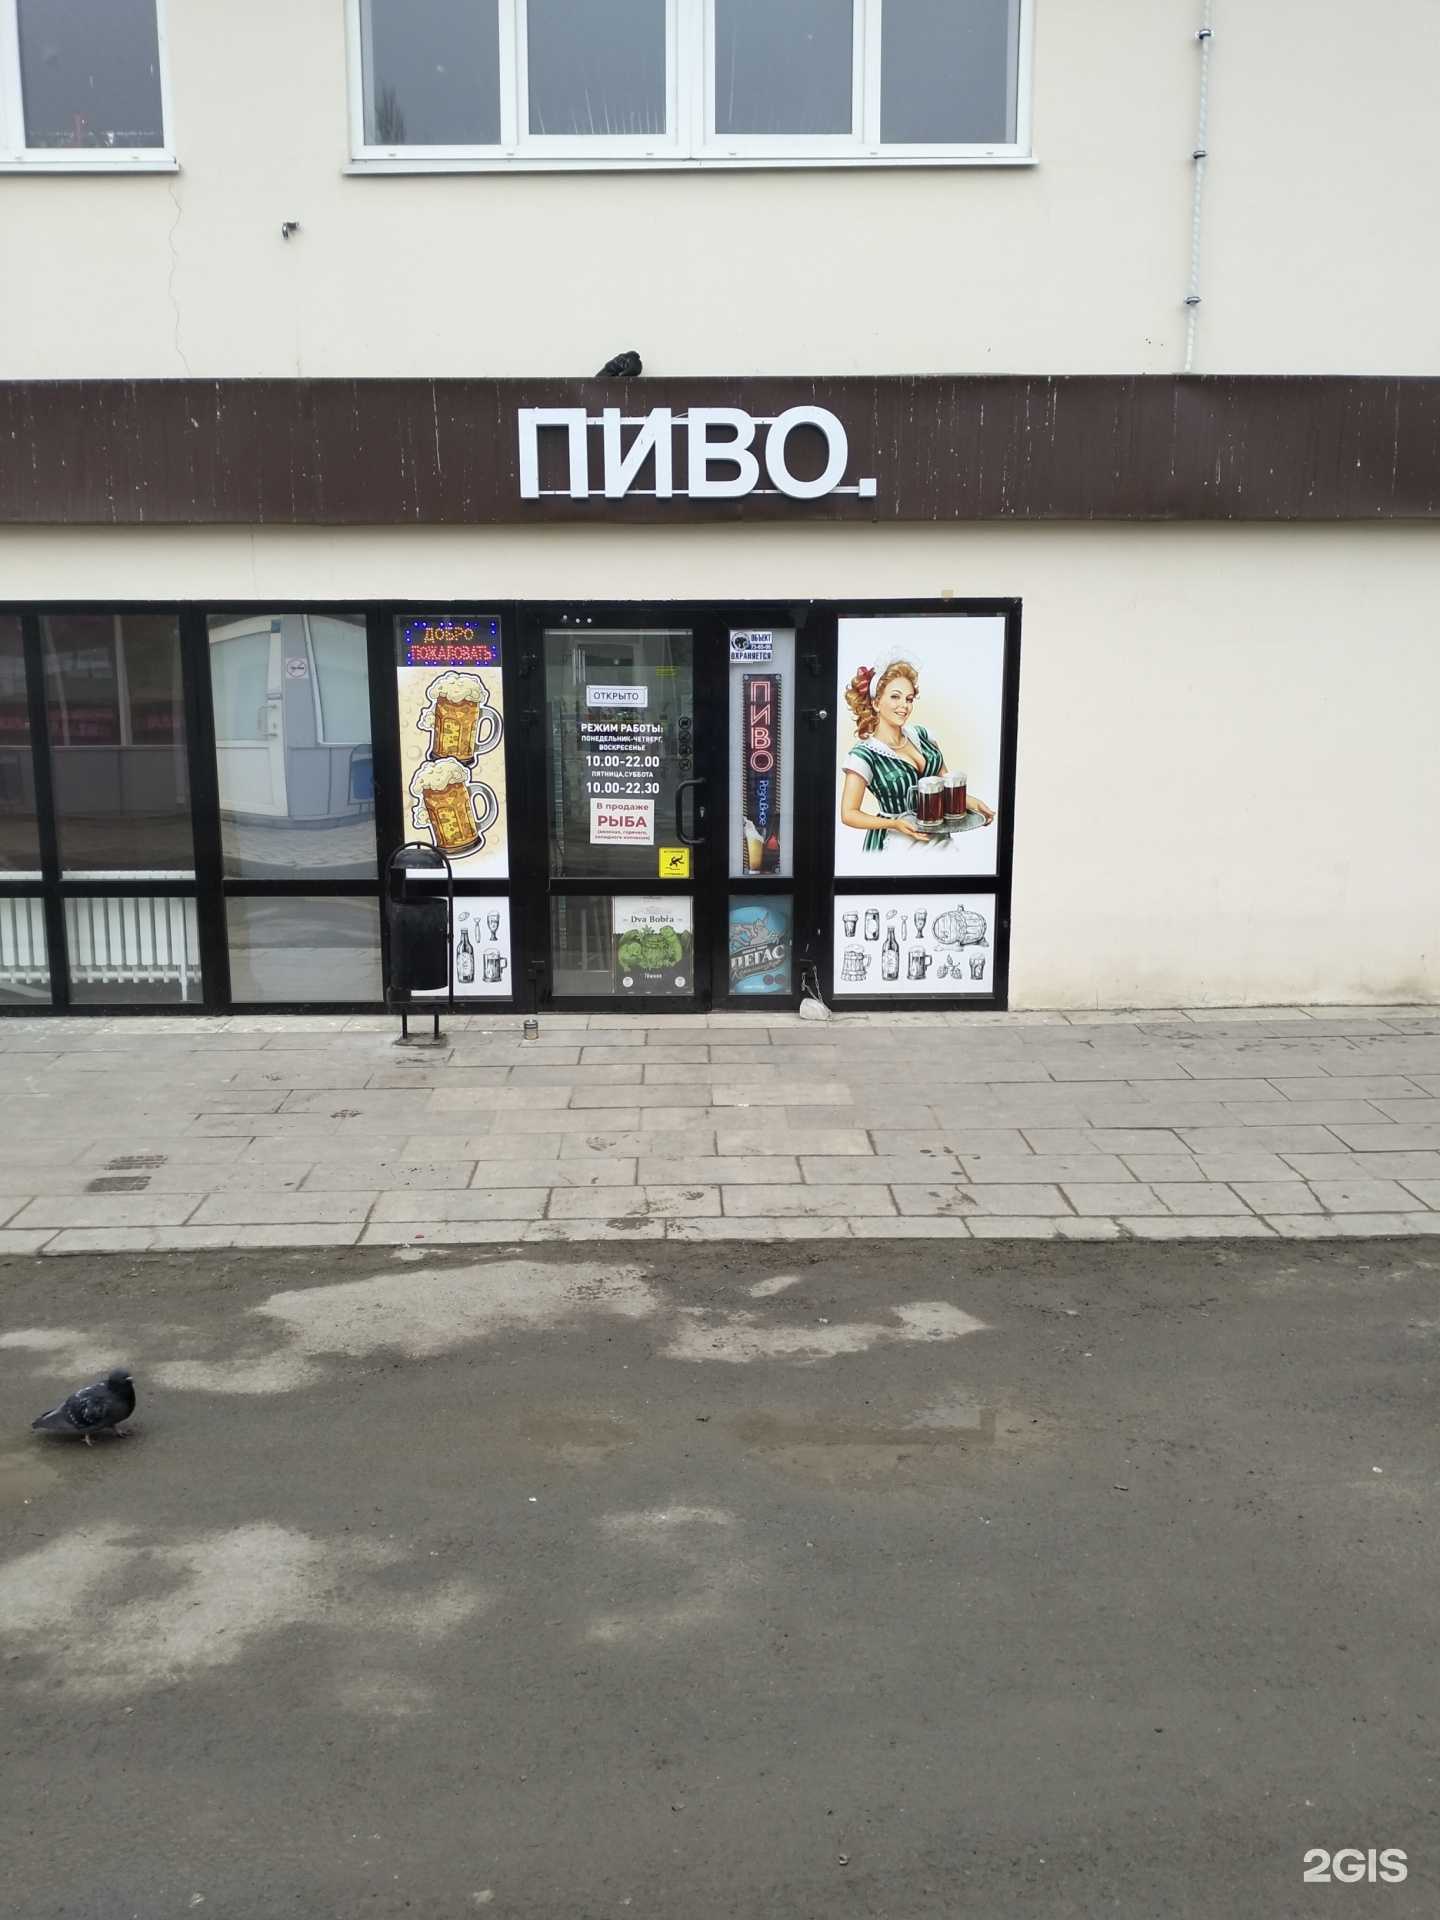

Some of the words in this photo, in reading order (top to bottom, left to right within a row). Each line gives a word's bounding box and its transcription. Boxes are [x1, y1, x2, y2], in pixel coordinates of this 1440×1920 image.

[518, 405, 877, 499] ПИВО.
[424, 627, 474, 643] ДОБРО
[411, 645, 492, 660] ПОЖАЛОВАТЬ
[731, 651, 771, 660] ОХРАНЯЕТСЯ
[593, 691, 639, 700] ОТКРЫТО
[581, 724, 618, 733] РЕЖИМ
[620, 724, 664, 733] РАБОТЫ:
[750, 681, 774, 772] ПИВО
[586, 756, 660, 767] 10.00-22.00
[586, 782, 660, 793] 10.00-22.30
[597, 816, 647, 827] РЫБА
[631, 915, 647, 923] Dva
